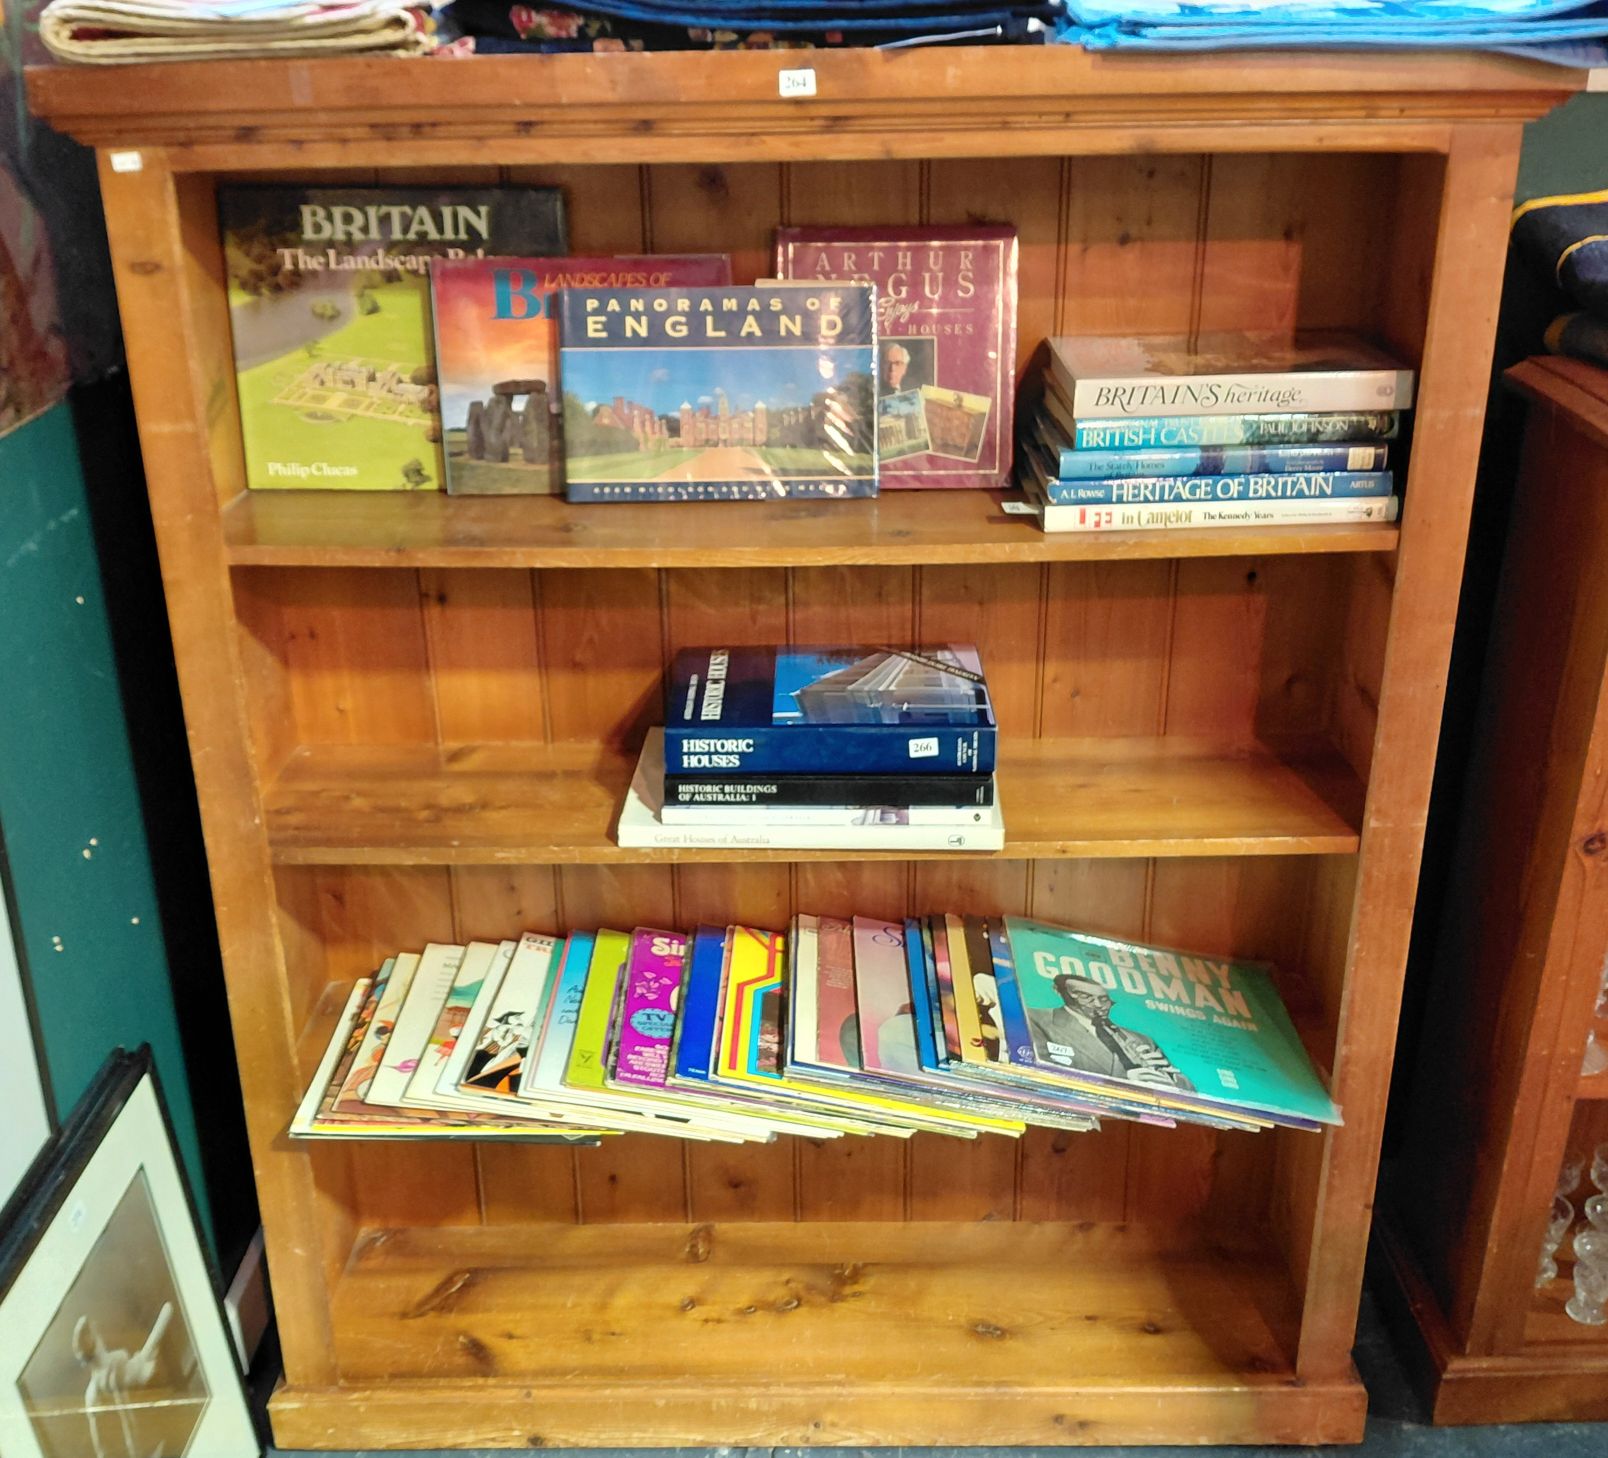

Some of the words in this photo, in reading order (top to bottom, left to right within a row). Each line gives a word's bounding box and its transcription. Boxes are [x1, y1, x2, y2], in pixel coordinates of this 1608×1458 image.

[300, 204, 490, 241] BRITAIN
[276, 248, 324, 270] The
[326, 248, 441, 274] Landscap
[815, 250, 974, 272] ARTHUR
[543, 273, 648, 289] LANDSCAPES
[650, 272, 673, 288] OF
[814, 271, 976, 300] GUS
[585, 297, 784, 312] PANORAMAS
[805, 296, 843, 311] OF
[586, 314, 843, 339] ENGLAND
[907, 323, 974, 336] HOUSES
[1094, 383, 1222, 414] BRITAIN'S
[1223, 382, 1303, 408] heritage
[1291, 419, 1350, 433] JOHNSON
[1082, 425, 1156, 449] BRITISH
[1111, 479, 1212, 503] HERITAGE
[1216, 478, 1246, 500] OF
[1248, 475, 1334, 498] BRITAIN
[1202, 511, 1217, 521] The
[1218, 510, 1253, 522] Kennedy
[681, 738, 755, 753] HISTORIC
[913, 742, 933, 753] 266
[681, 754, 741, 768] HOUSES
[677, 784, 723, 794] HISTORIC
[723, 784, 778, 794] BUILDINGS
[677, 793, 691, 802] OF
[683, 832, 717, 844] Houses
[729, 833, 771, 845] Australia
[1107, 946, 1232, 989] BENNY
[1032, 951, 1252, 1019] GOODMAN
[641, 1012, 666, 1022] TV
